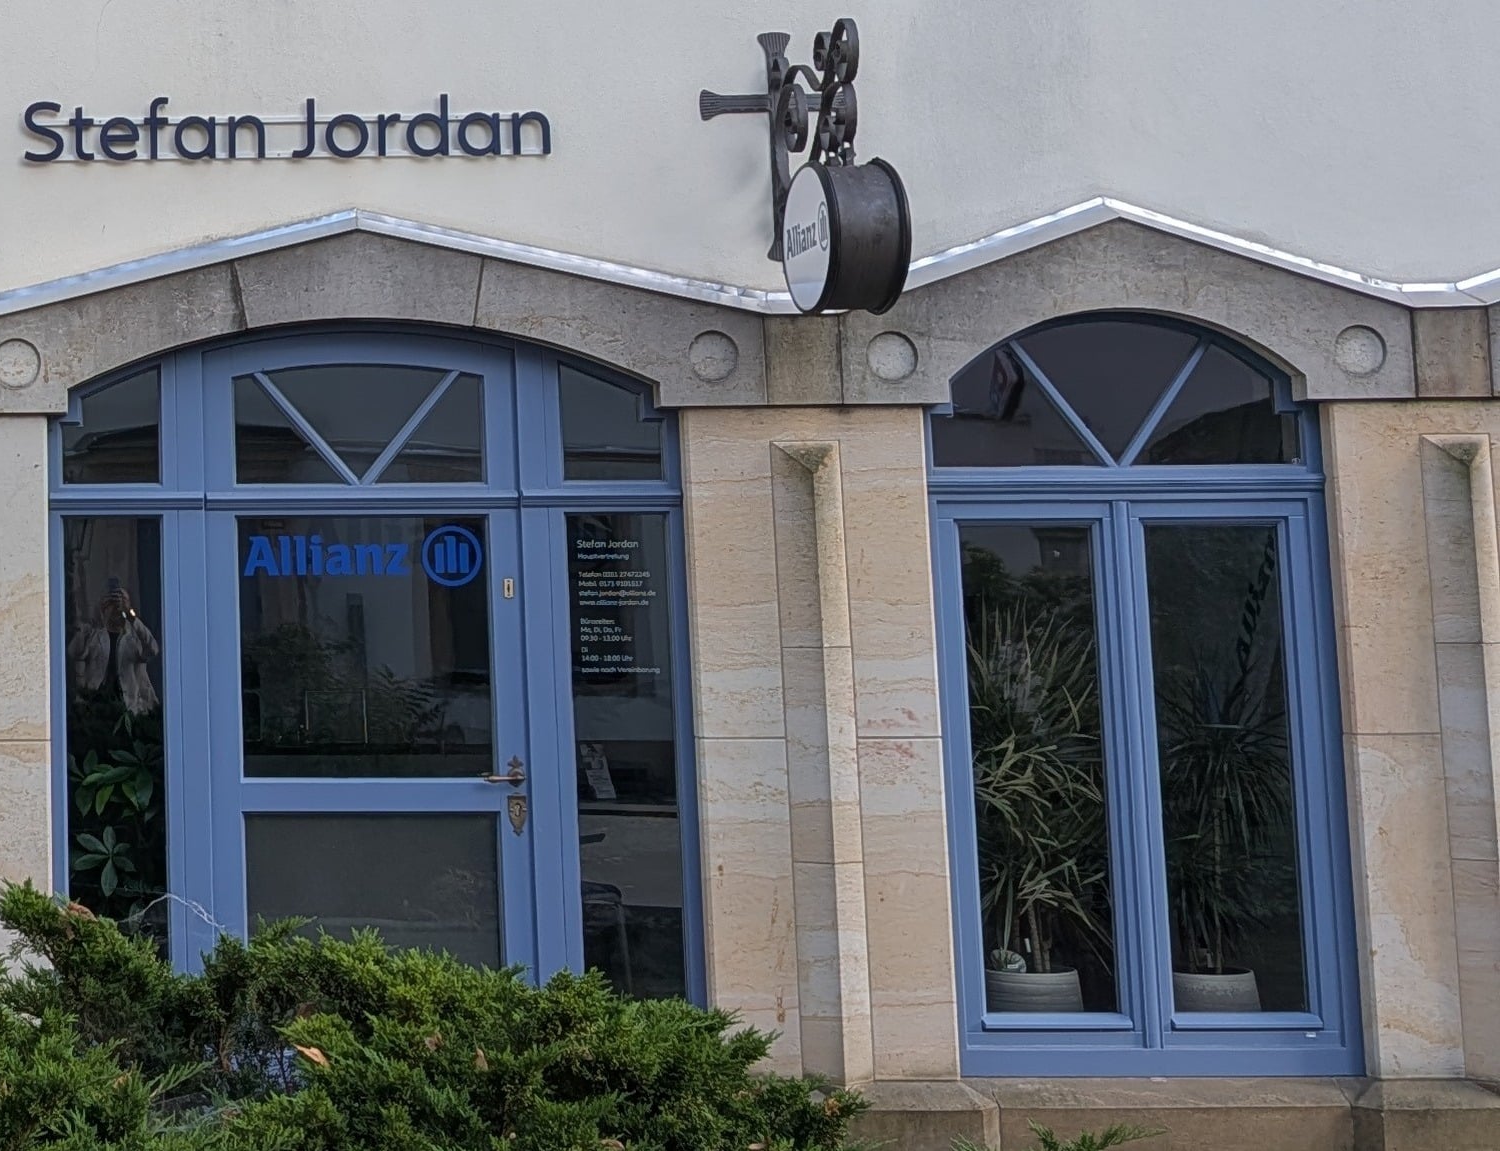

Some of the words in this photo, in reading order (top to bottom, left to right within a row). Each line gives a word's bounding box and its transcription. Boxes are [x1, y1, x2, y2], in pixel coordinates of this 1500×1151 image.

[23, 96, 266, 163] Stefan
[291, 93, 551, 158] Jordan
[786, 221, 818, 261] Allianz
[244, 534, 410, 577] Allianz
[576, 540, 606, 549] Stefan
[608, 540, 639, 549] Jordan
